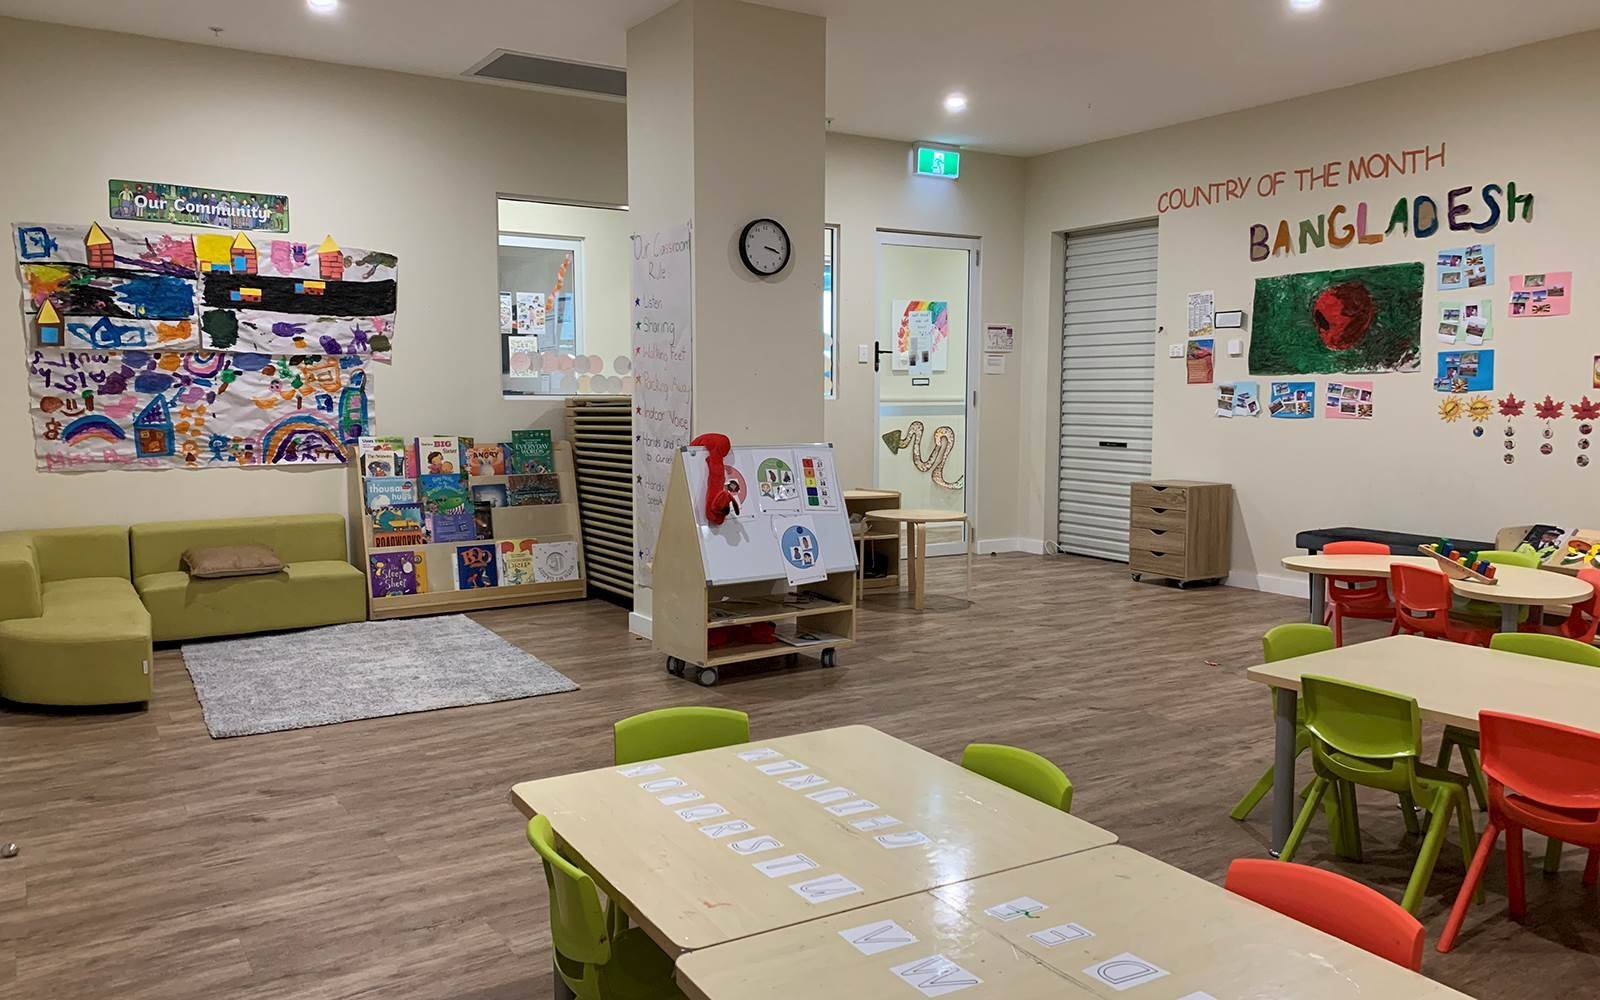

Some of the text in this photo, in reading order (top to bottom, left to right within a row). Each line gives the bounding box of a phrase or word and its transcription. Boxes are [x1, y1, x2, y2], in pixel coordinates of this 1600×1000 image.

[1157, 142, 1445, 213] COUNTRY OF THE MONTH
[134, 195, 268, 223] Our Community
[433, 440, 452, 448] BIG
[473, 450, 499, 459] ANGRY
